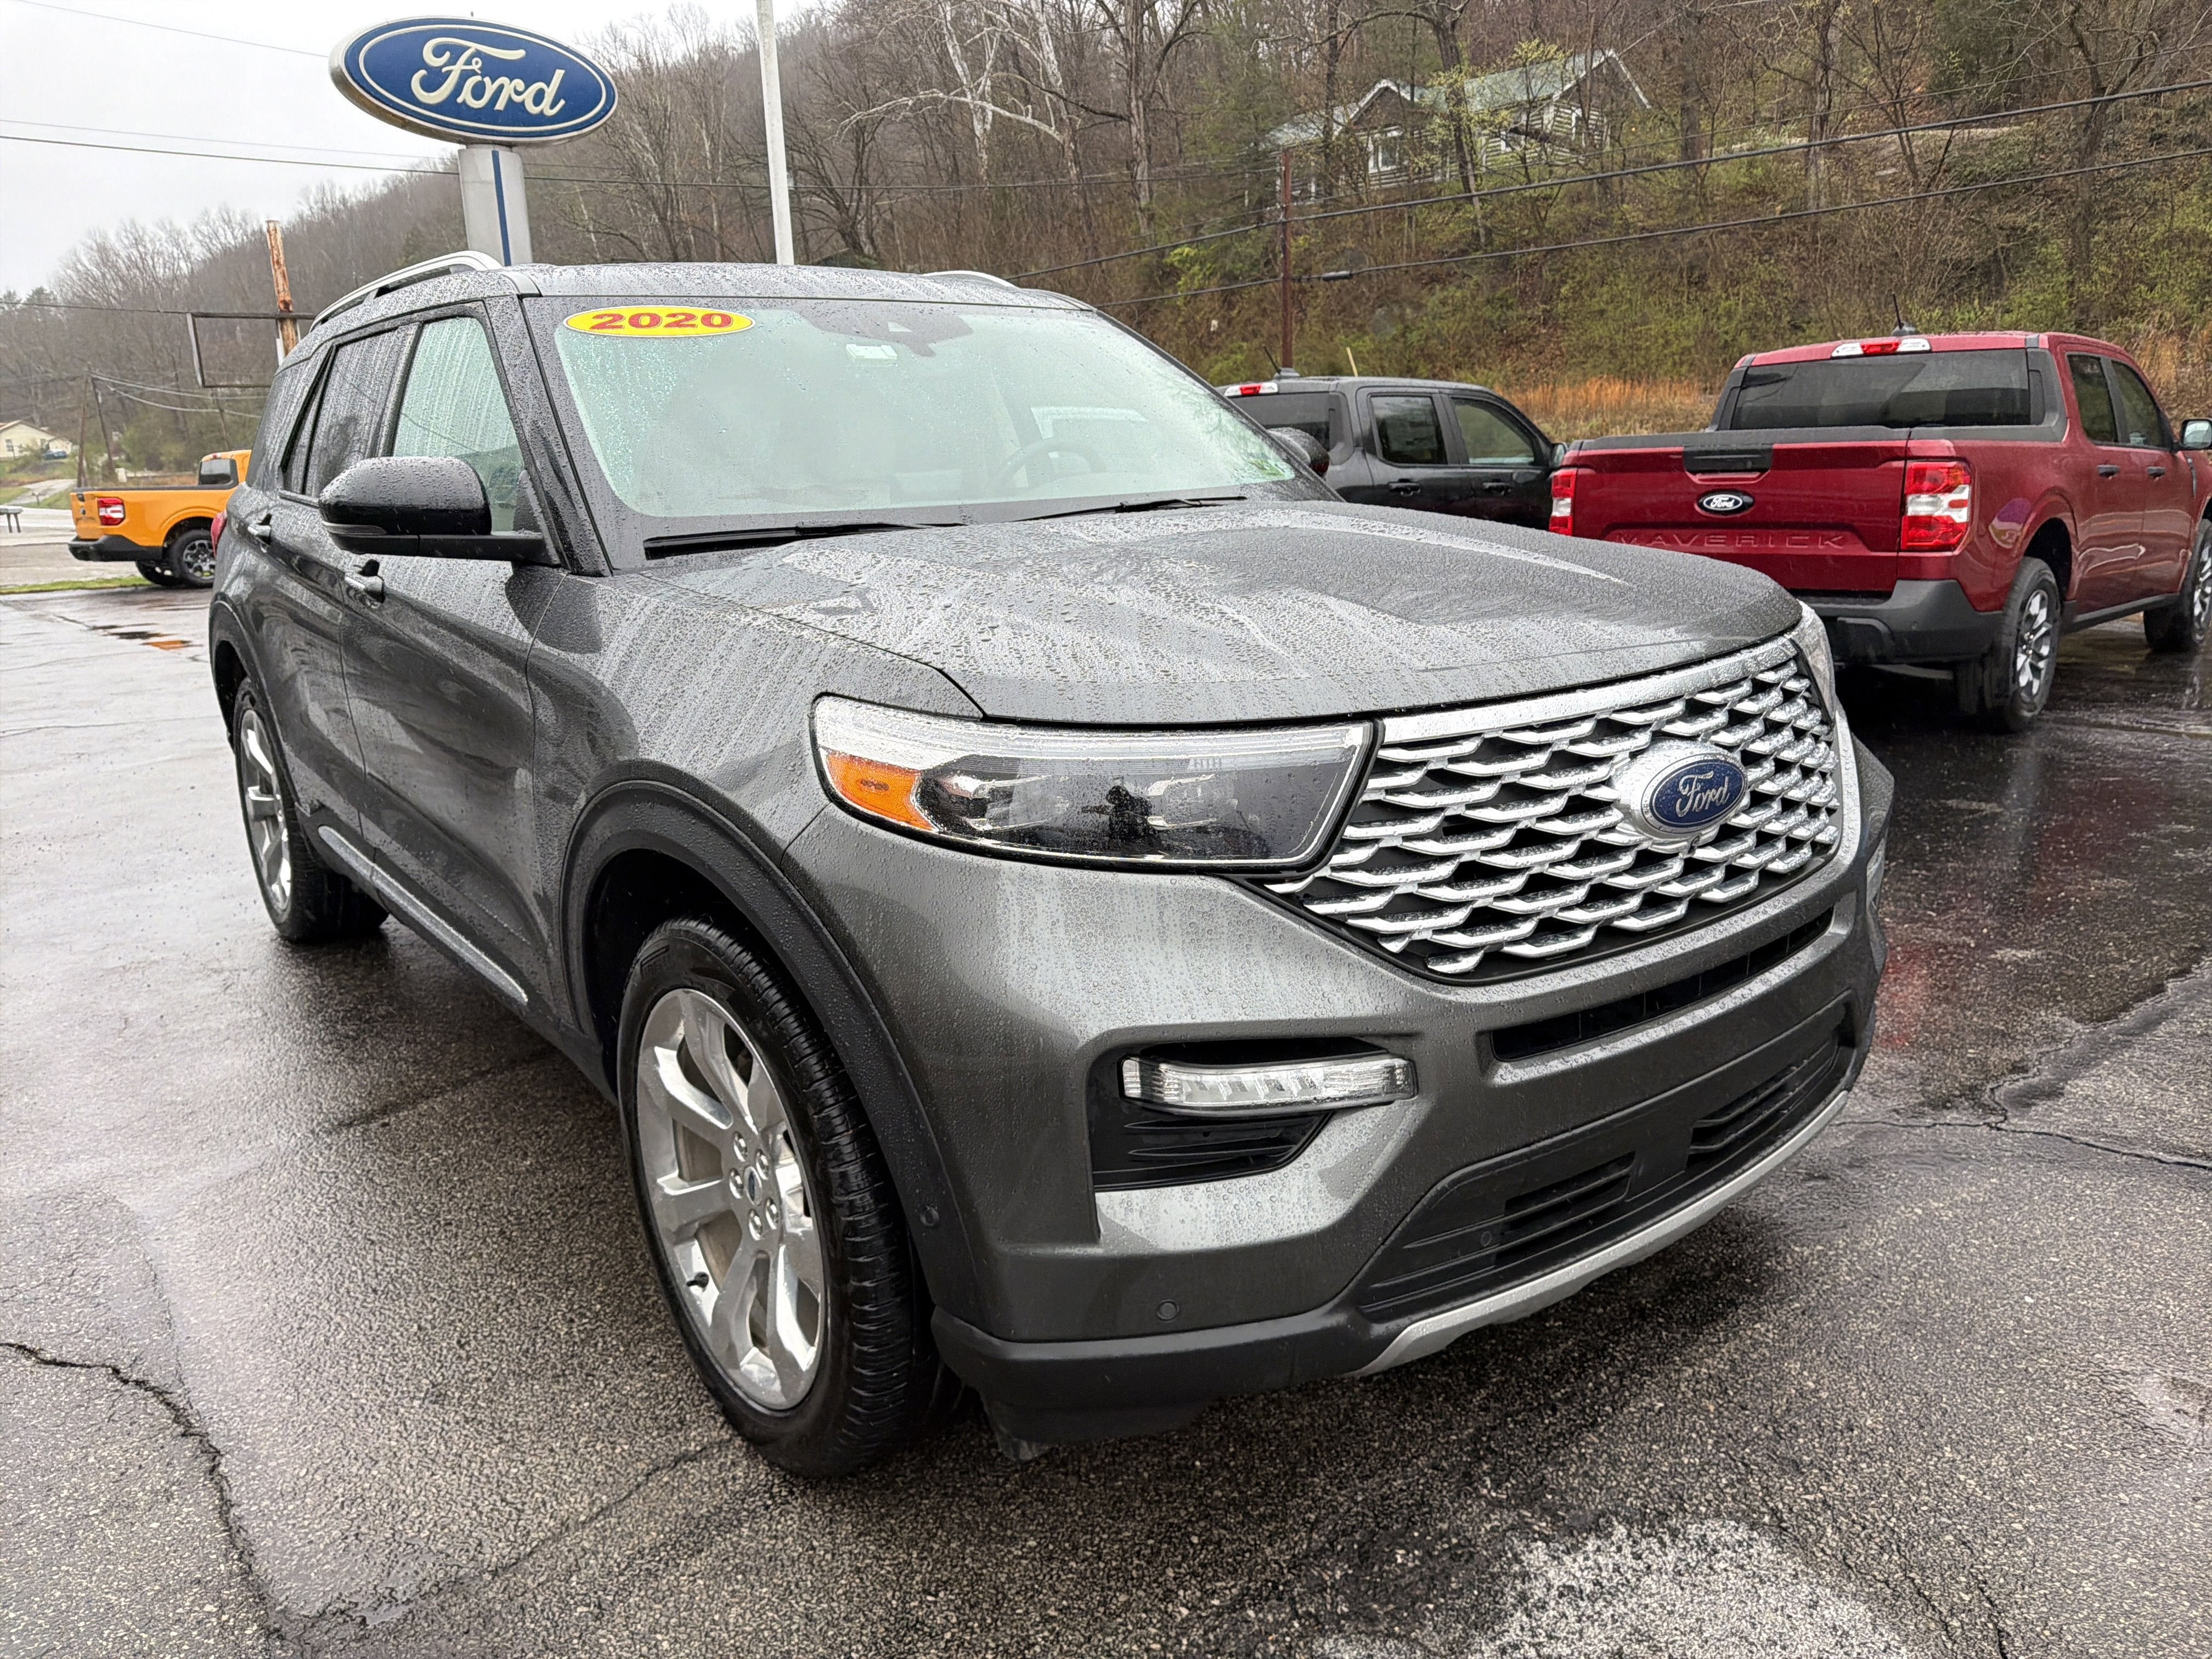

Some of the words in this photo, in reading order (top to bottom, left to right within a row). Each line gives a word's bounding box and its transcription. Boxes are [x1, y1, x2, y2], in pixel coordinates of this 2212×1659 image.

[411, 37, 566, 116] Ford
[589, 312, 733, 330] 2020
[1710, 496, 1735, 508] Ford
[1616, 534, 1843, 549] MAVERICK
[1675, 770, 1730, 817] Ford
